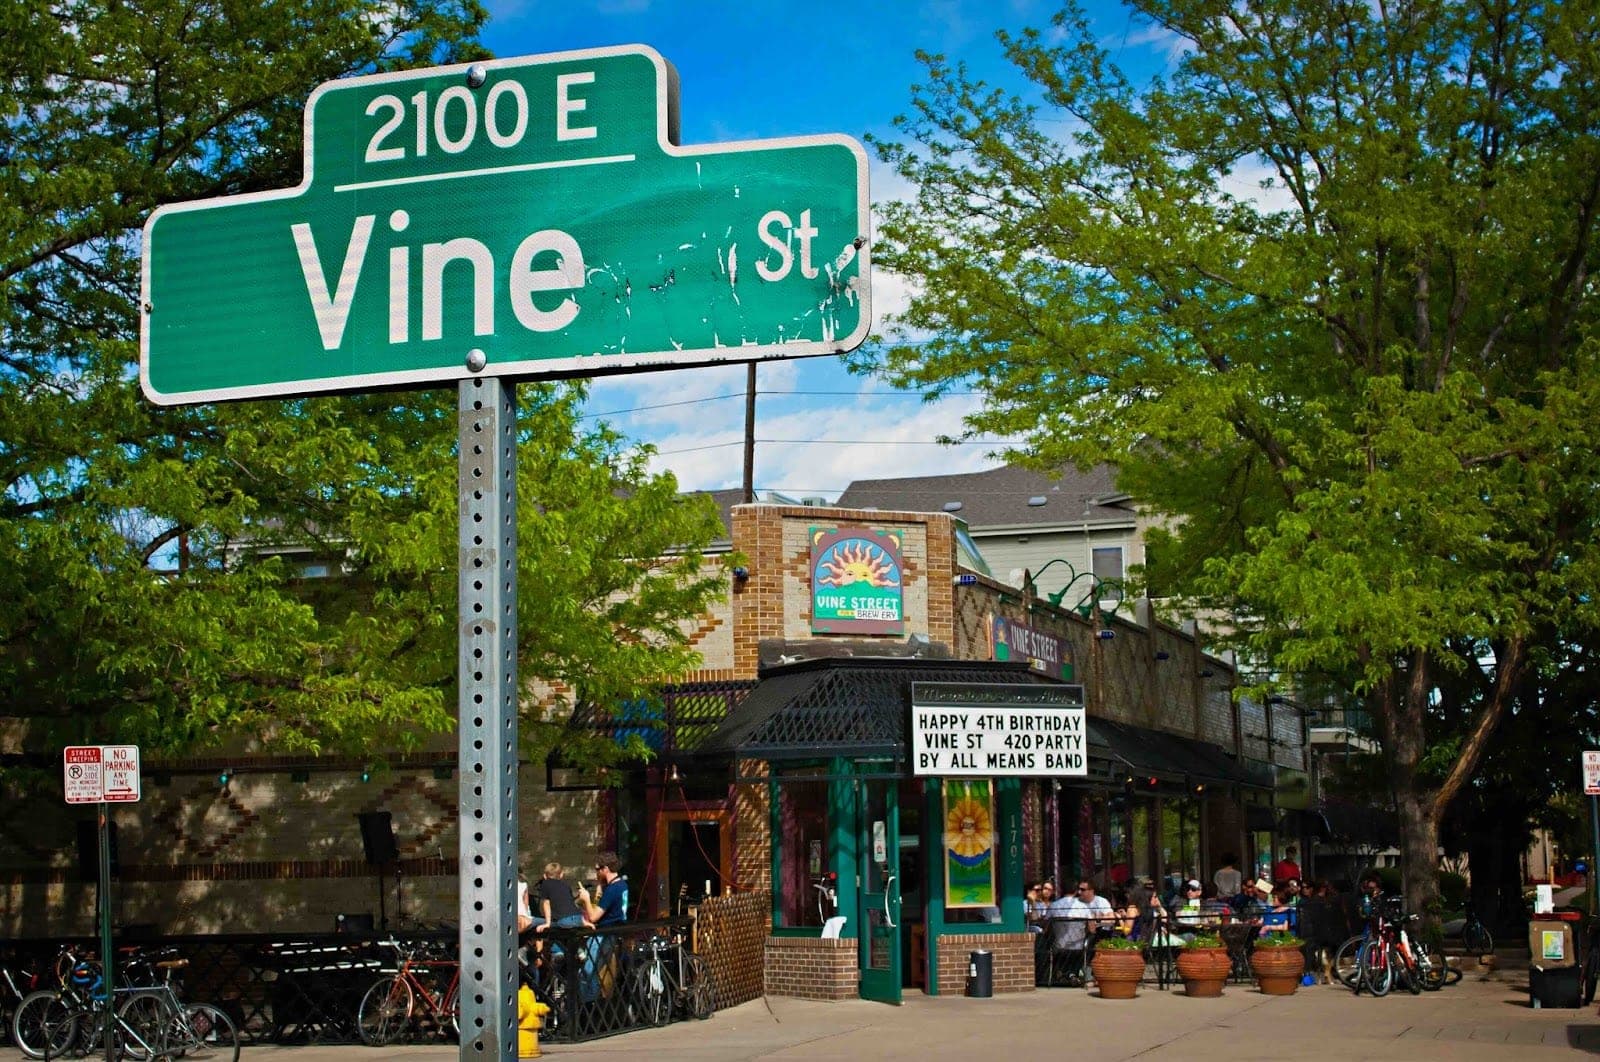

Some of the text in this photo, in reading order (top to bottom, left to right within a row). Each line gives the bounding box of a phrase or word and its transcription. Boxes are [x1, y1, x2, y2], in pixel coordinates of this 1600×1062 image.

[364, 71, 598, 164] 2100 E
[290, 208, 820, 351] Vine St
[816, 595, 899, 610] VINE STREET
[1010, 624, 1031, 656] VINE
[1031, 631, 1059, 664] STREET
[919, 714, 1082, 731] HAPPY 4TH BIRTHDAY
[924, 733, 1082, 750] VINE ST 420 PARTY
[113, 750, 127, 760] NO
[920, 753, 1083, 769] BY ALL MEANS BAND
[105, 760, 135, 771] PARKING
